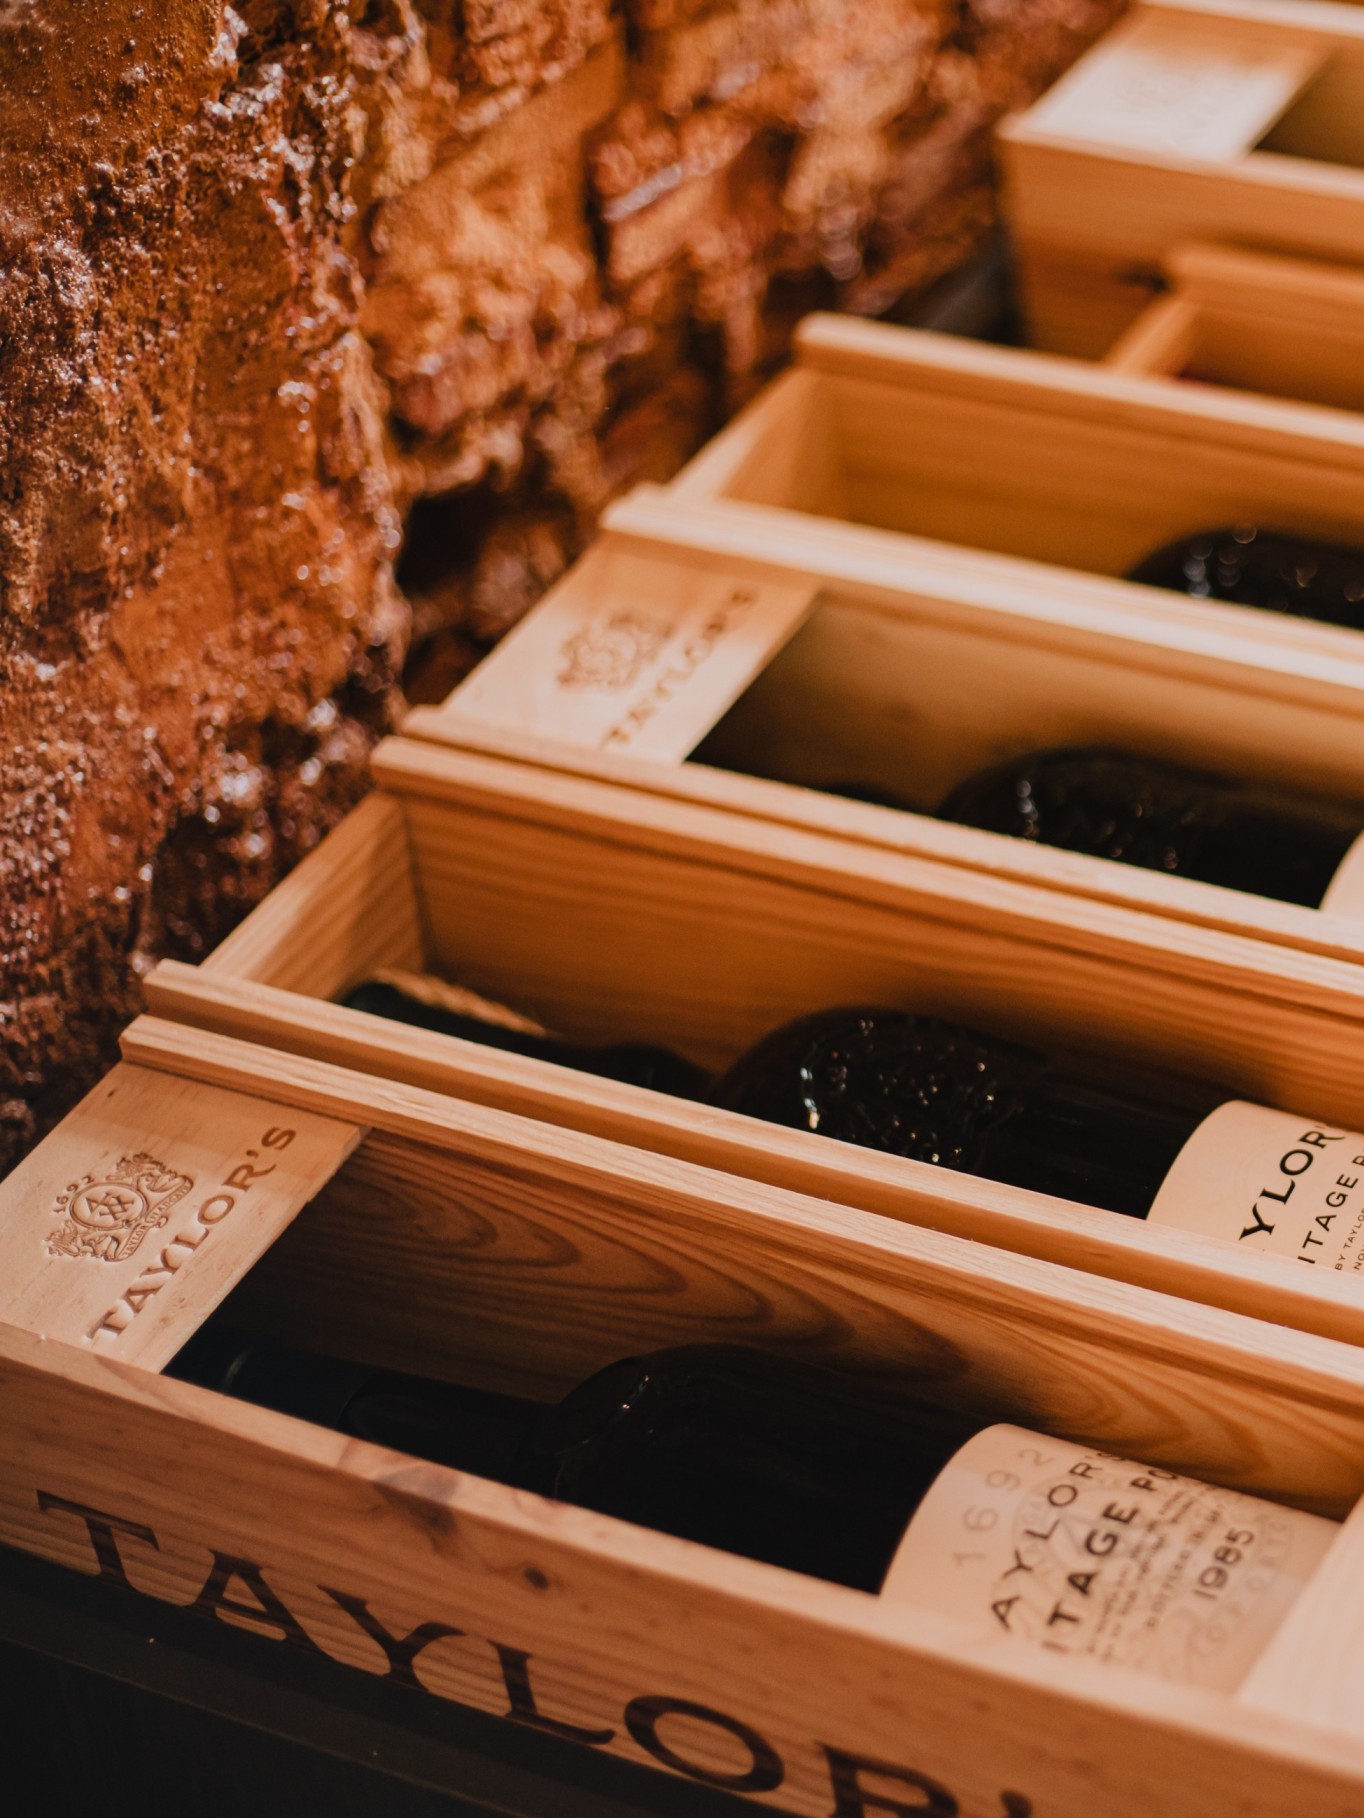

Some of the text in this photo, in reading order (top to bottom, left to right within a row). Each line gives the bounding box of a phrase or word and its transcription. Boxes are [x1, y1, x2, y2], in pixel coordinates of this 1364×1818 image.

[52, 1173, 96, 1214] 1692
[86, 1125, 298, 1342] TAYLOR'S
[1334, 1254, 1347, 1271] BY
[1193, 1527, 1255, 1600] 1985
